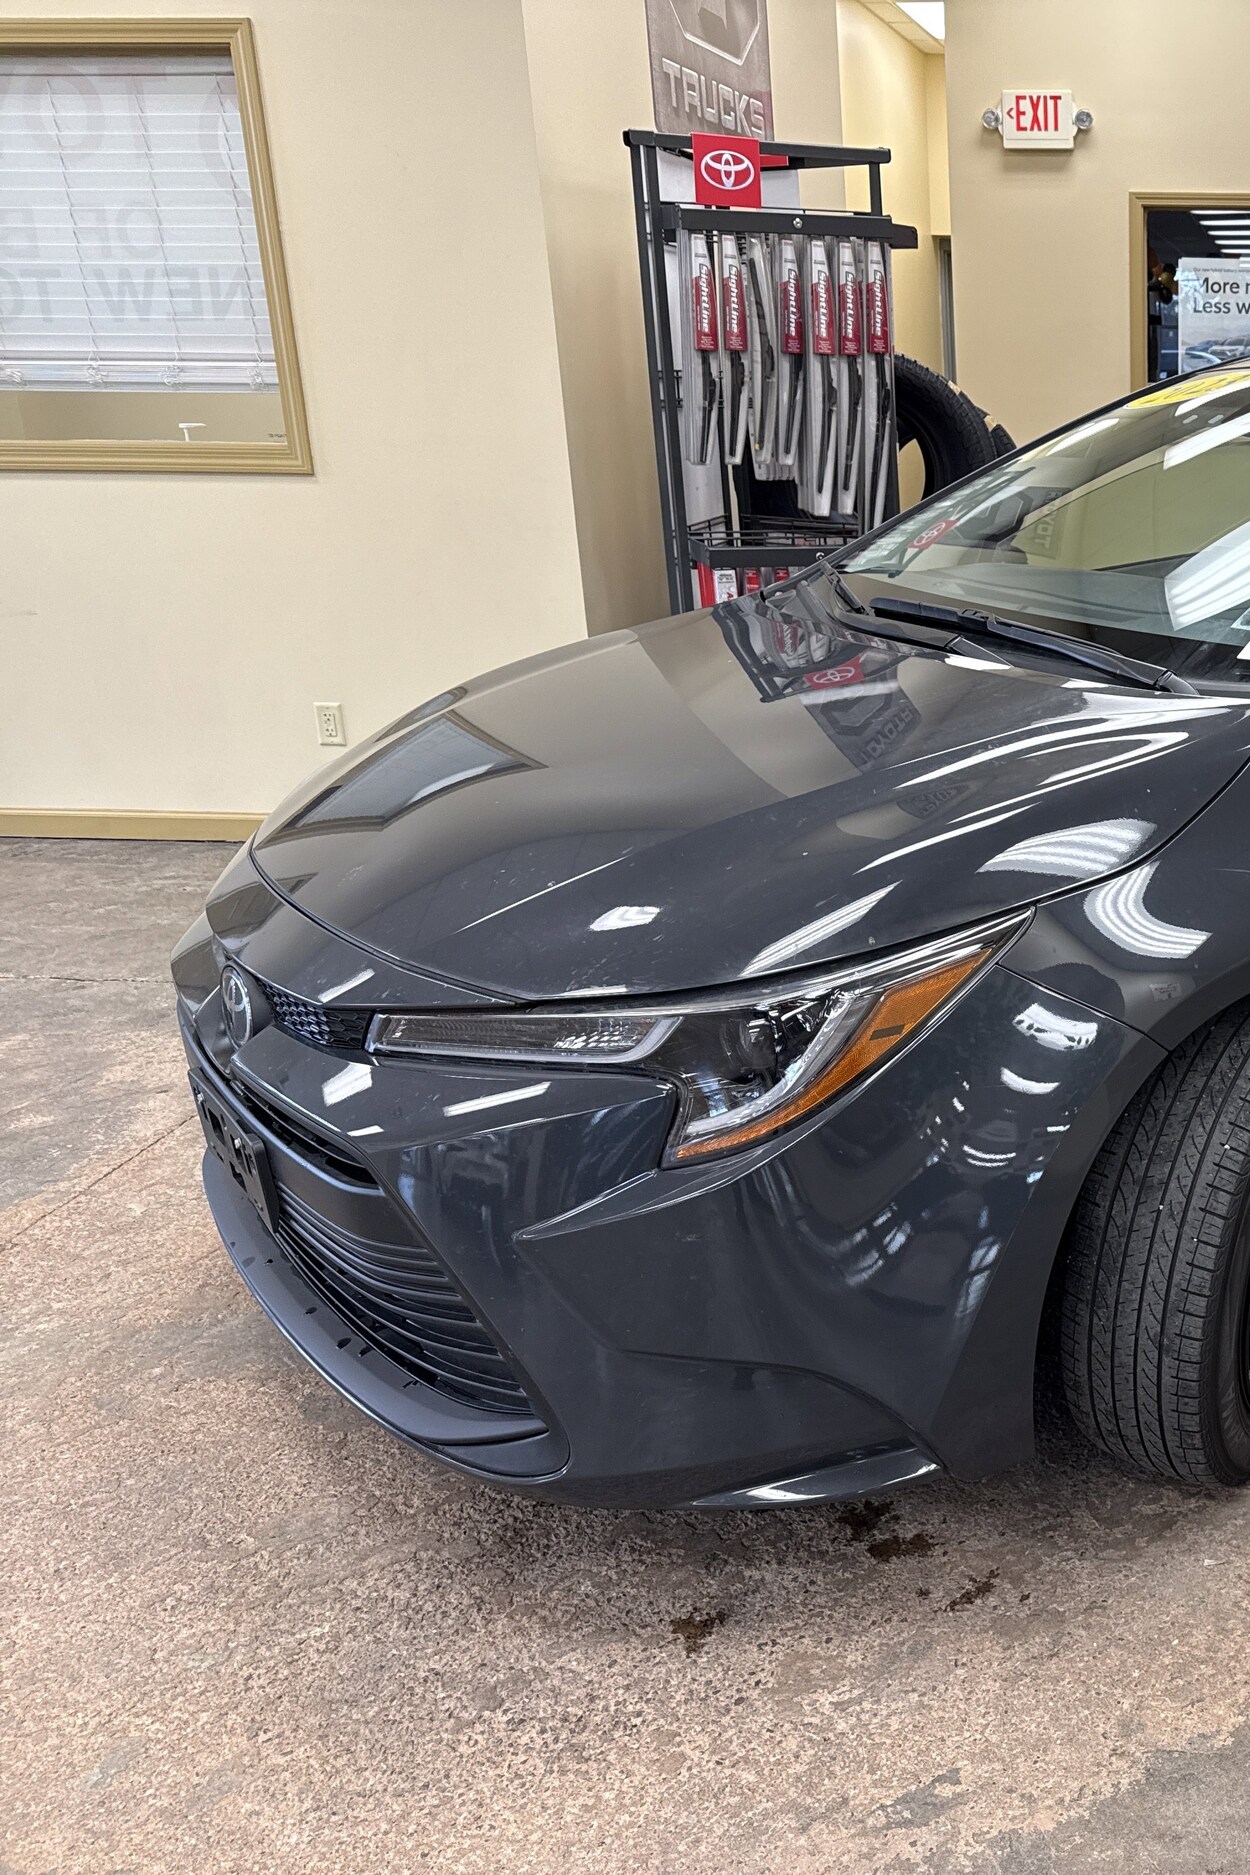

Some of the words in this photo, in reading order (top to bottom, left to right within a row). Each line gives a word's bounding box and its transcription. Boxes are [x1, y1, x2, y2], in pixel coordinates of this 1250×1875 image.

[662, 57, 765, 140] TRUCKS
[1015, 95, 1062, 131] EXIT
[1193, 297, 1231, 313] Less
